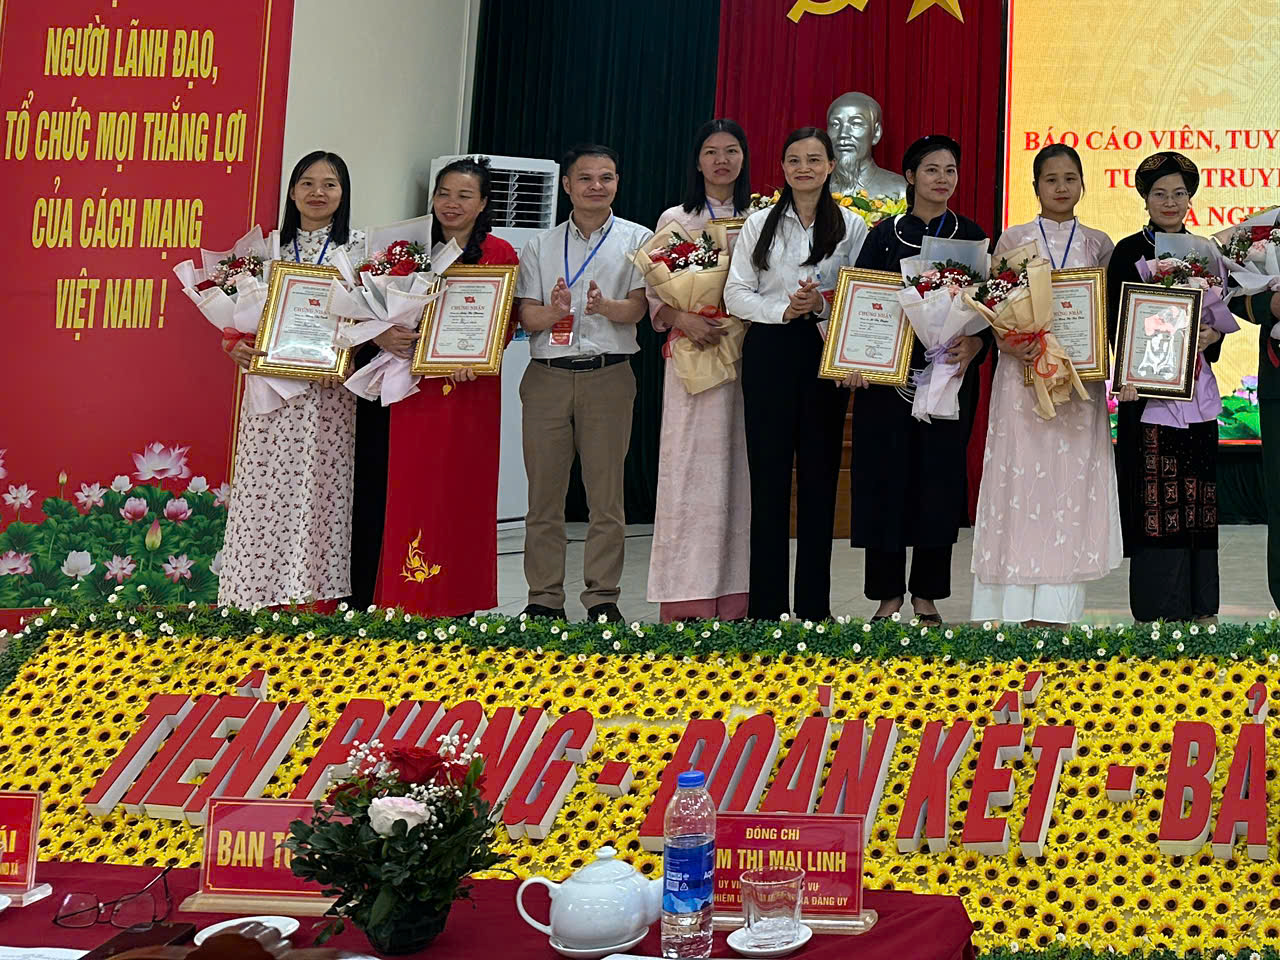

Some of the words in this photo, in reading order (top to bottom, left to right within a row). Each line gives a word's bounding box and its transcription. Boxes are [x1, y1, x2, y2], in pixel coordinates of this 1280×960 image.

[44, 15, 109, 77] NGƯỜI
[113, 18, 168, 78] LÃNH
[172, 29, 218, 89] ĐẠO,
[4, 90, 34, 161] TỔ
[35, 96, 91, 161] CHỨC
[95, 111, 138, 173] MỌI
[143, 95, 209, 162] THẮNG
[213, 109, 247, 174] LỢI
[1086, 125, 1142, 150] CÁO
[1149, 124, 1221, 153] VIÊN,
[32, 176, 73, 249] CỦA
[79, 187, 136, 249] CÁCH
[140, 198, 203, 260] MẠNG
[55, 268, 100, 341] VIỆT
[103, 278, 153, 329] NAM
[84, 670, 309, 819] TIÊN
[896, 671, 1077, 857] KẾT
[216, 830, 265, 868] BAN
[769, 850, 801, 871] MAI
[807, 851, 847, 873] LINH
